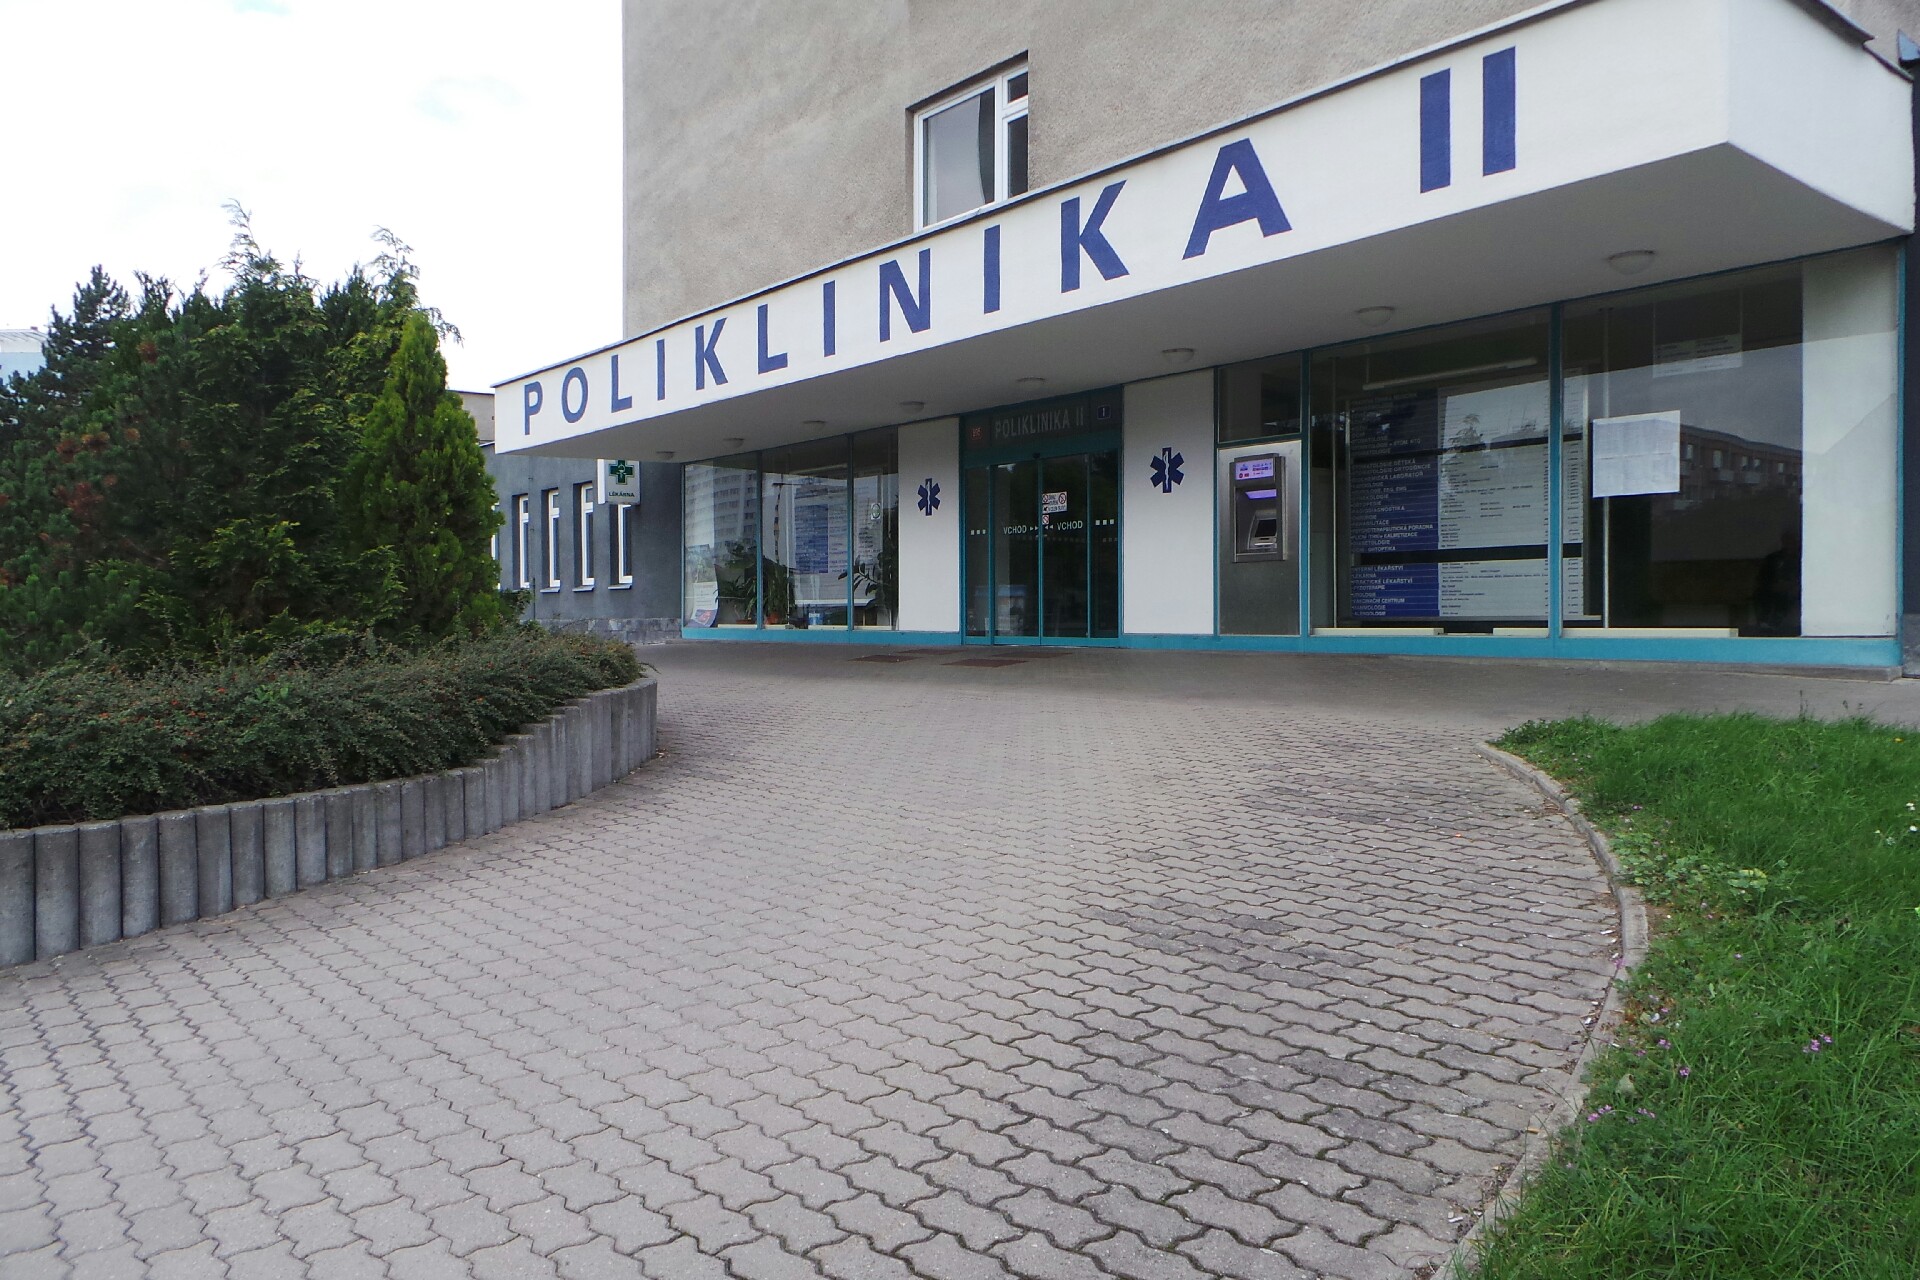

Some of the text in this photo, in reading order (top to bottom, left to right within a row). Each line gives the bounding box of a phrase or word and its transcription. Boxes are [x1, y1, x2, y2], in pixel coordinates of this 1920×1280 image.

[524, 46, 1516, 434] POLIKLINIKA II
[995, 408, 1071, 439] POLIKLINIKA
[1075, 407, 1084, 426] II
[1003, 525, 1027, 534] VCHOD
[1057, 521, 1083, 531] VCHOD
